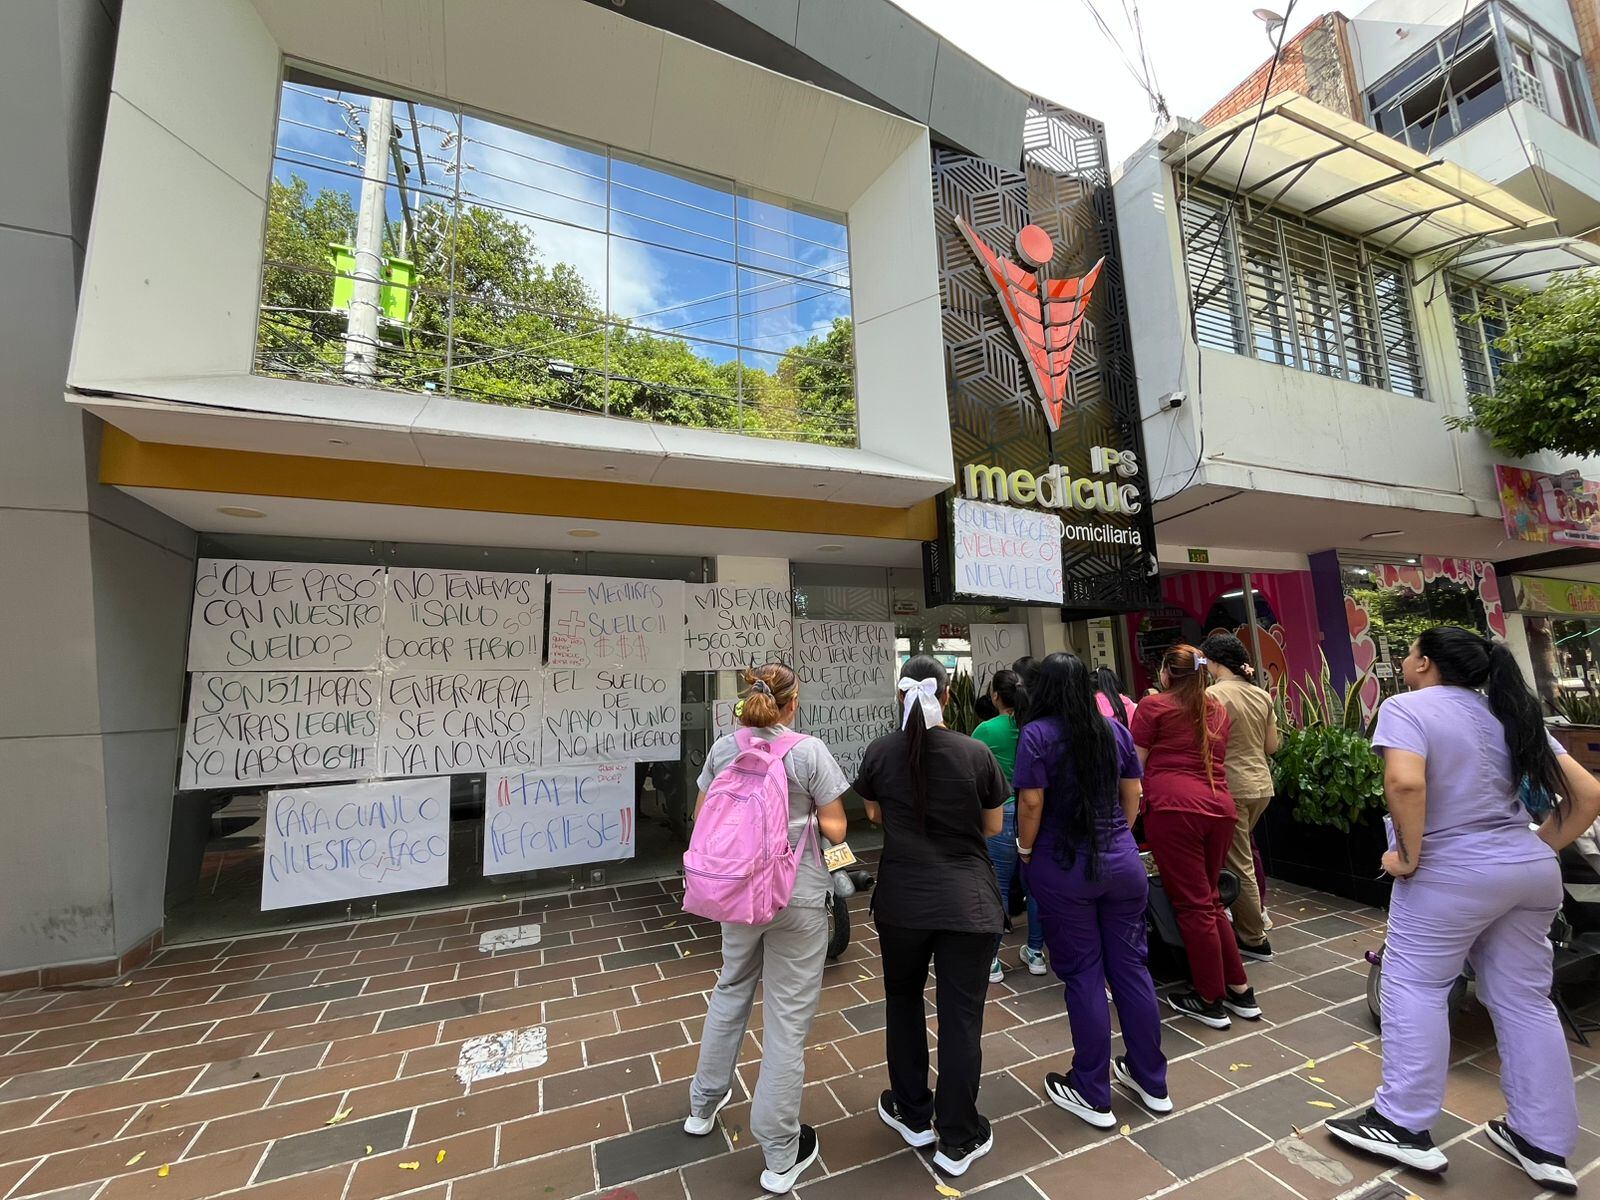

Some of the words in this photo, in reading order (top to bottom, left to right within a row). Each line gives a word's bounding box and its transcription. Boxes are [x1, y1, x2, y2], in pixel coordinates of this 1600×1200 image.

[964, 463, 1141, 515] medicuc
[394, 571, 434, 602] NO
[440, 573, 530, 604] TENEMOS
[204, 600, 263, 628] CON
[273, 600, 381, 629] NUESTRO
[227, 630, 352, 666] SUELDO?
[553, 671, 584, 693] EL
[596, 671, 667, 693] SUELDO
[603, 692, 630, 709] DE
[193, 713, 290, 745] EXTRAS
[297, 710, 377, 740] LEGALES
[396, 709, 436, 740] SE
[546, 708, 603, 737] MAYO
[608, 710, 618, 729] Y
[622, 706, 677, 732] JUNIO
[558, 736, 588, 762] NO
[592, 732, 616, 754] HA
